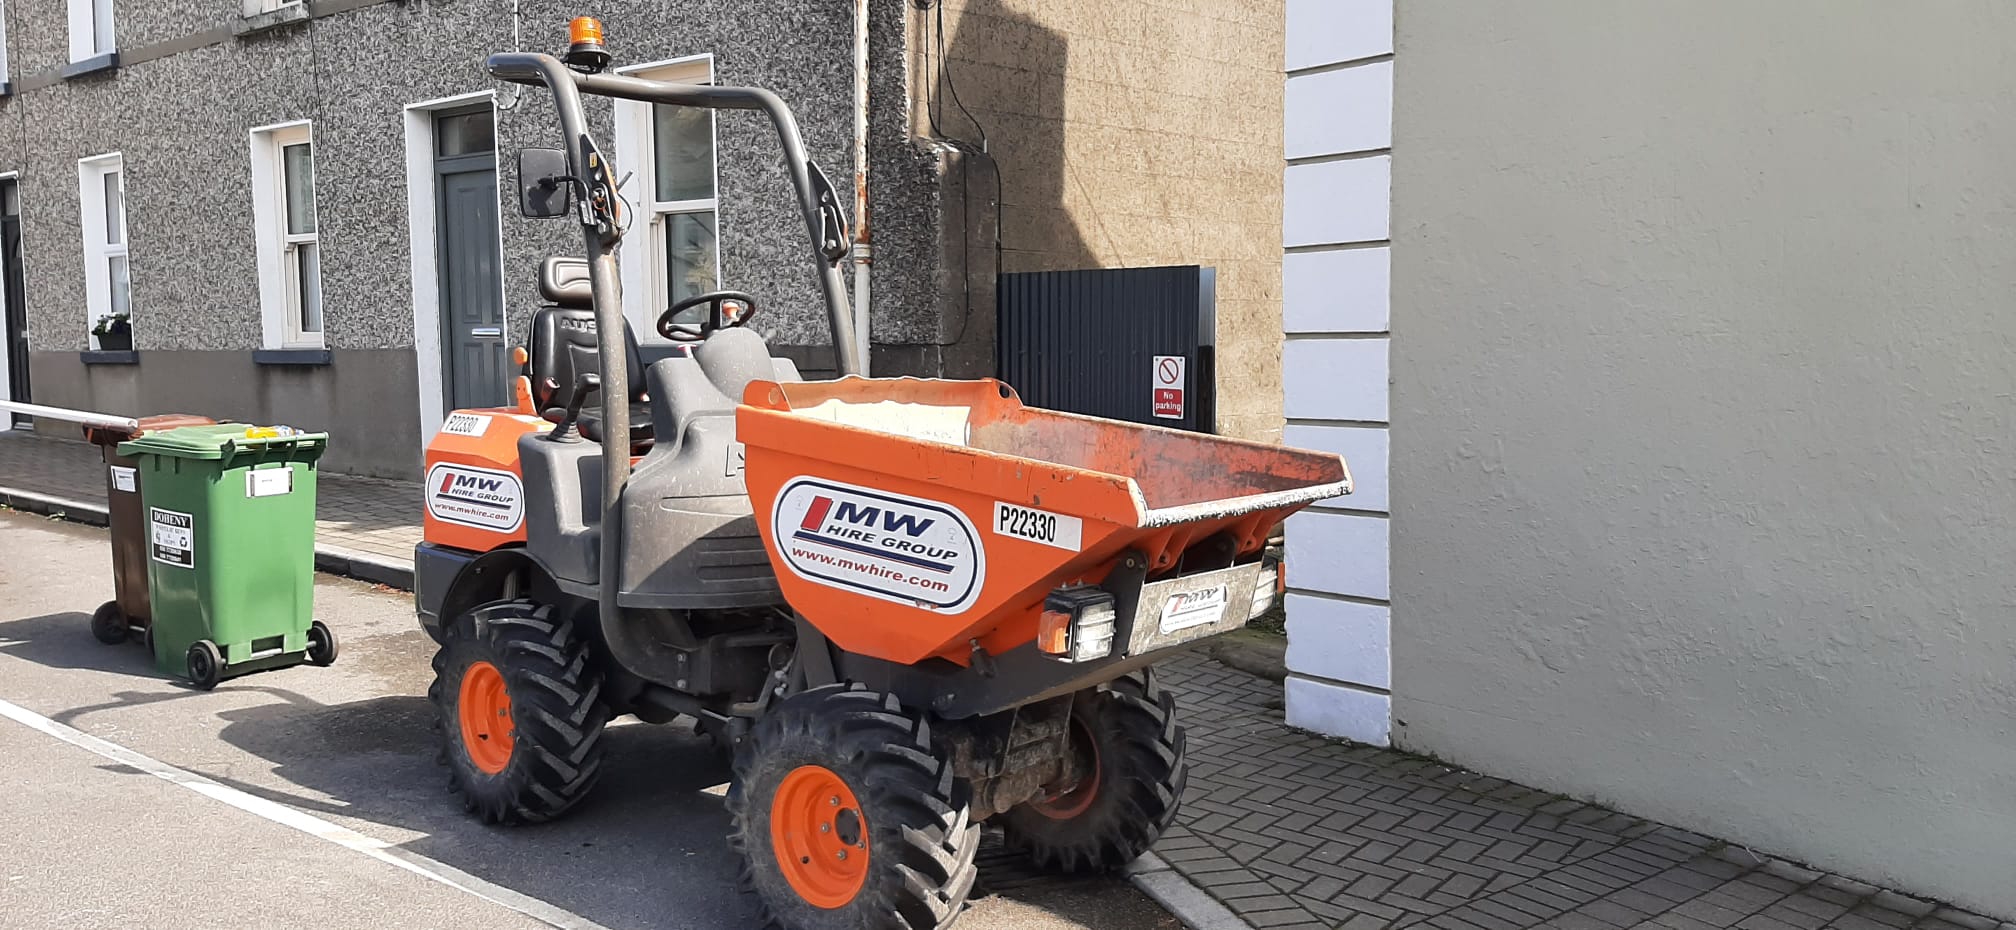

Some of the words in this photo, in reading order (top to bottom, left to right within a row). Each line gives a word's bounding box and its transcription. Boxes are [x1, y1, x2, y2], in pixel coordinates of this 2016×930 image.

[1163, 391, 1174, 400] No
[1155, 401, 1182, 412] parking
[445, 415, 479, 433] P22330
[455, 475, 503, 492] MW
[451, 488, 474, 498] HIRE
[476, 492, 514, 503] GROUP
[154, 511, 188, 527] DOHENY
[434, 503, 509, 521] www.mwhire.com
[834, 501, 936, 538] MW
[1000, 505, 1056, 543] P22330
[826, 524, 877, 544] HIRE
[881, 537, 959, 561] GROUP
[791, 547, 949, 593] www.mwhire.com
